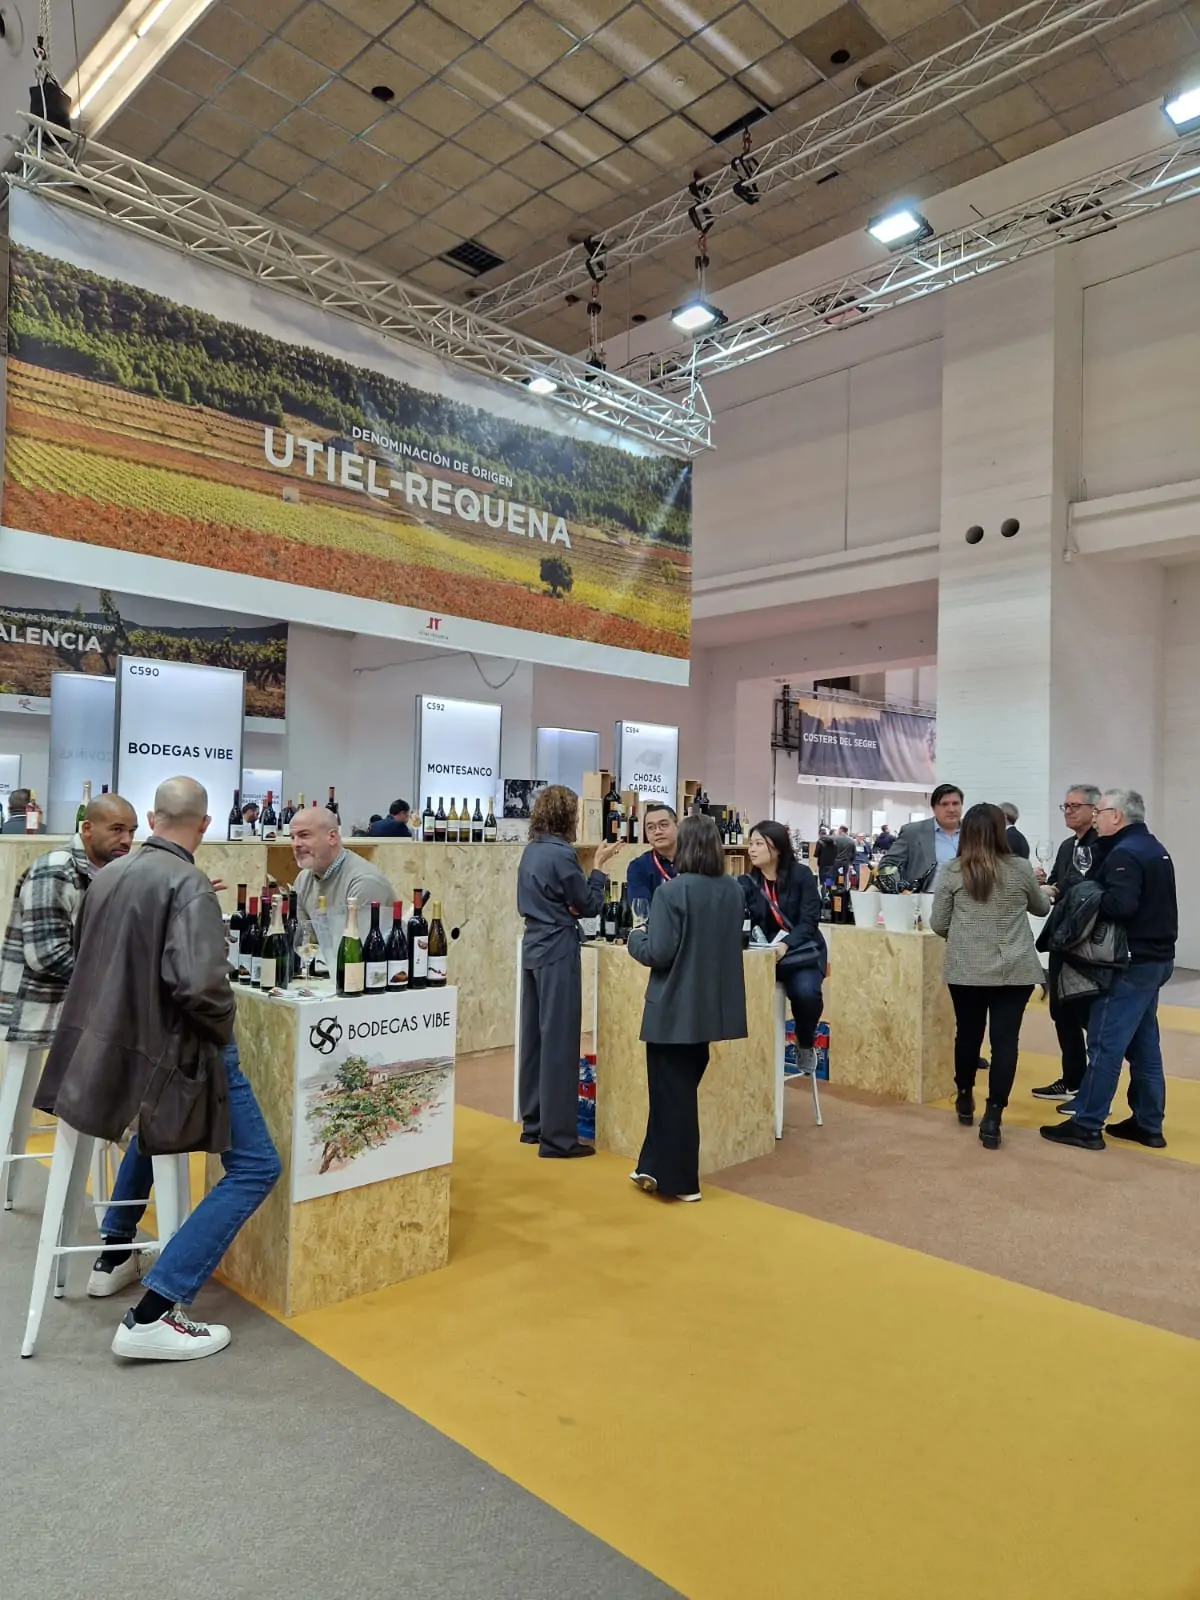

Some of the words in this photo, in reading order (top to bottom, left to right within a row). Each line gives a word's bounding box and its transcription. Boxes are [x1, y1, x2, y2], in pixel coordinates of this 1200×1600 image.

[352, 425, 450, 469] DENOMINACIÓN
[453, 459, 469, 474] DE
[471, 466, 513, 488] ORIGEN
[264, 427, 571, 549] UTIEL-REQUENA
[129, 665, 160, 677] C590
[426, 702, 445, 712] C592
[803, 732, 838, 745] COSTERS
[839, 736, 852, 747] DEL
[854, 738, 877, 749] SEGRE
[128, 742, 200, 758] BODEGAS
[204, 747, 233, 760] VIBE
[427, 763, 493, 777] MONTESANCO
[633, 773, 662, 783] CHOZAS
[629, 783, 669, 794] CARRASCAL
[348, 1015, 418, 1040] BODEGAS
[422, 1011, 451, 1029] VIBE
